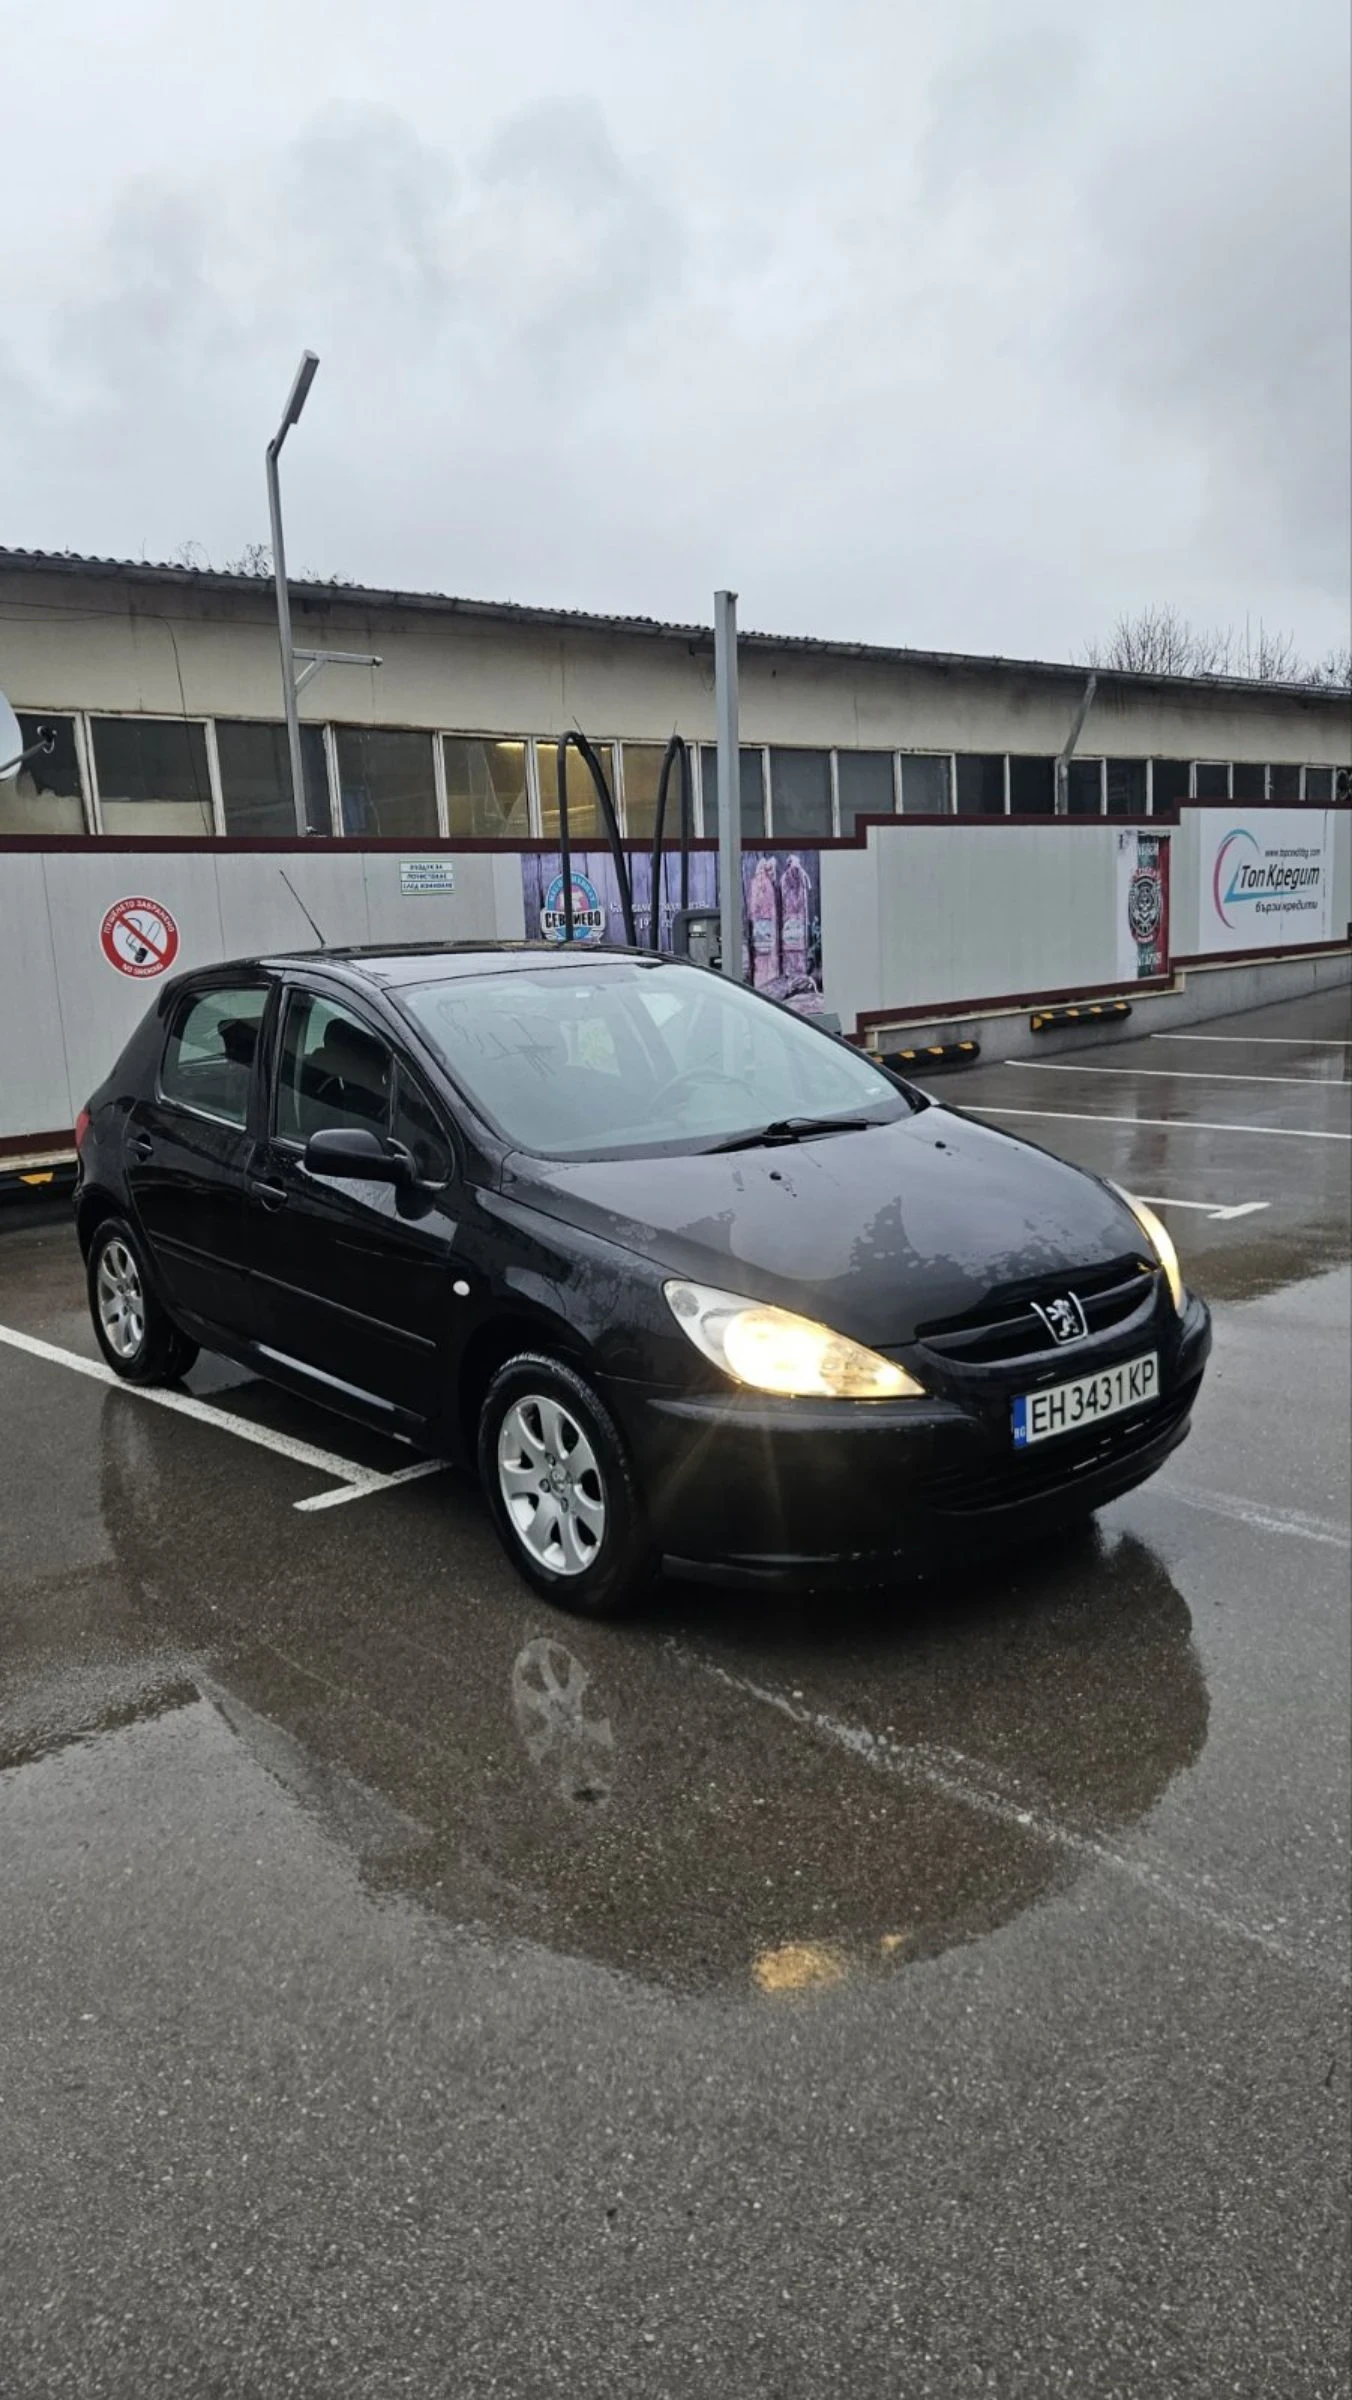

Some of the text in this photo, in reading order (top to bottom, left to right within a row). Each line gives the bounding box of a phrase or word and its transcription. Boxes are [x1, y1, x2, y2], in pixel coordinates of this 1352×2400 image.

[103, 899, 175, 934] ПУШЕНЕТО ЗАБРАНЕНО
[545, 910, 601, 928] СЕВИЕВО
